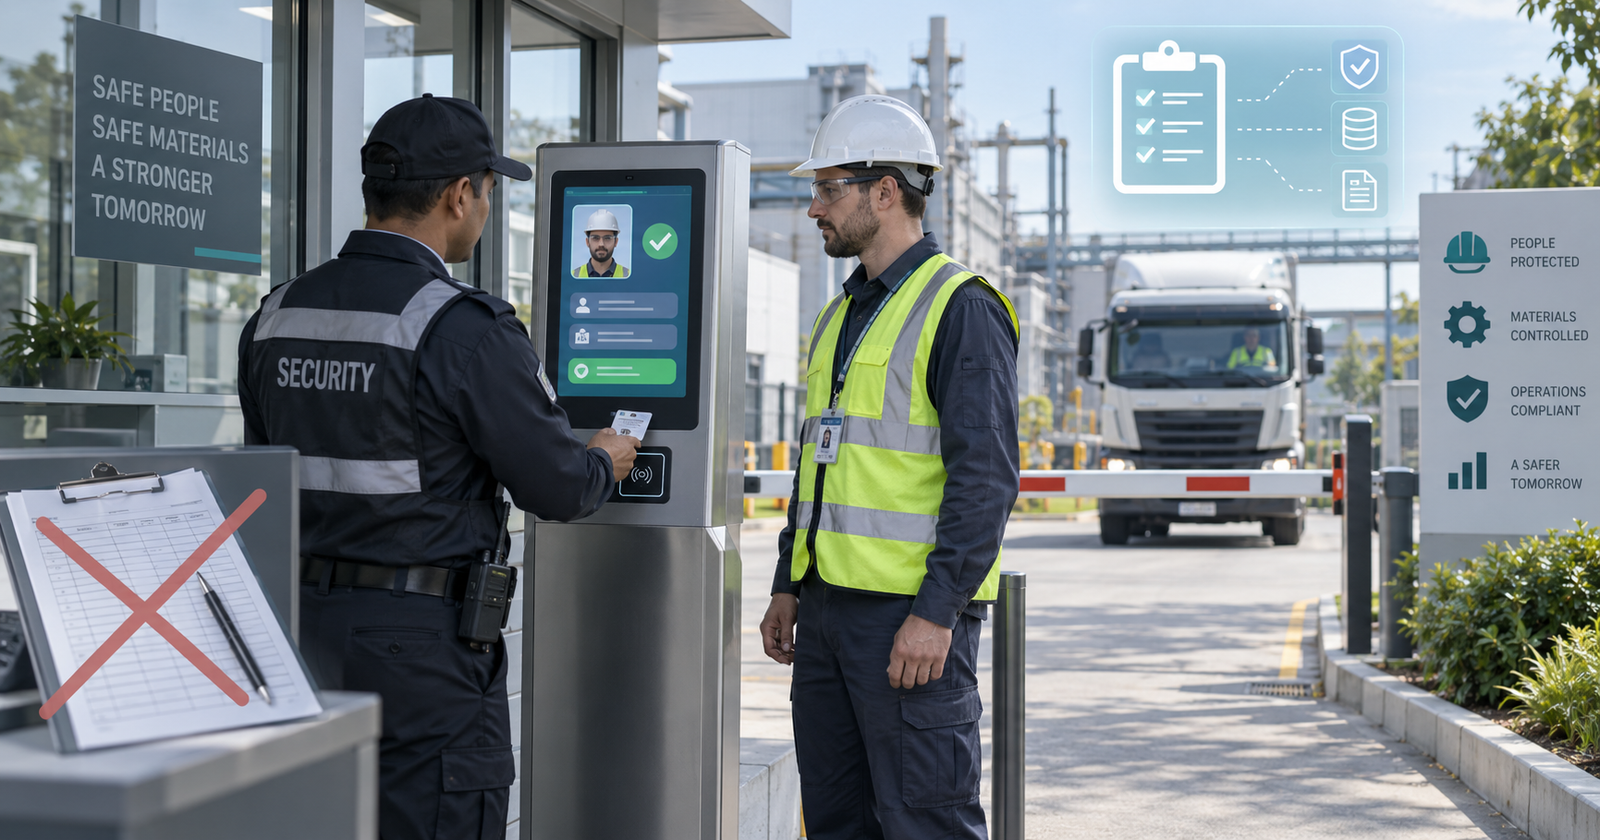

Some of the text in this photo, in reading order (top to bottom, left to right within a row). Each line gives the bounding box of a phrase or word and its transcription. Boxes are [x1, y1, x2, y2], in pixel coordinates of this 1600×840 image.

[92, 74, 219, 123] SAFE PEOPLE
[92, 114, 249, 165] SAFE MATERIALS
[91, 154, 213, 196] A STRONGER
[91, 193, 206, 231] TOMORROW
[1510, 237, 1556, 249] PEOPLE
[1510, 256, 1580, 268] PROTECTED
[1510, 311, 1577, 323] MATERIALS
[1510, 329, 1589, 342] CONTROLLED
[277, 357, 376, 393] SECURITY
[1510, 385, 1587, 398] OPERATIONS
[1510, 404, 1581, 417] COMPLIANT
[1510, 459, 1560, 471] A SAFER
[1510, 477, 1583, 490] TOMORROW
